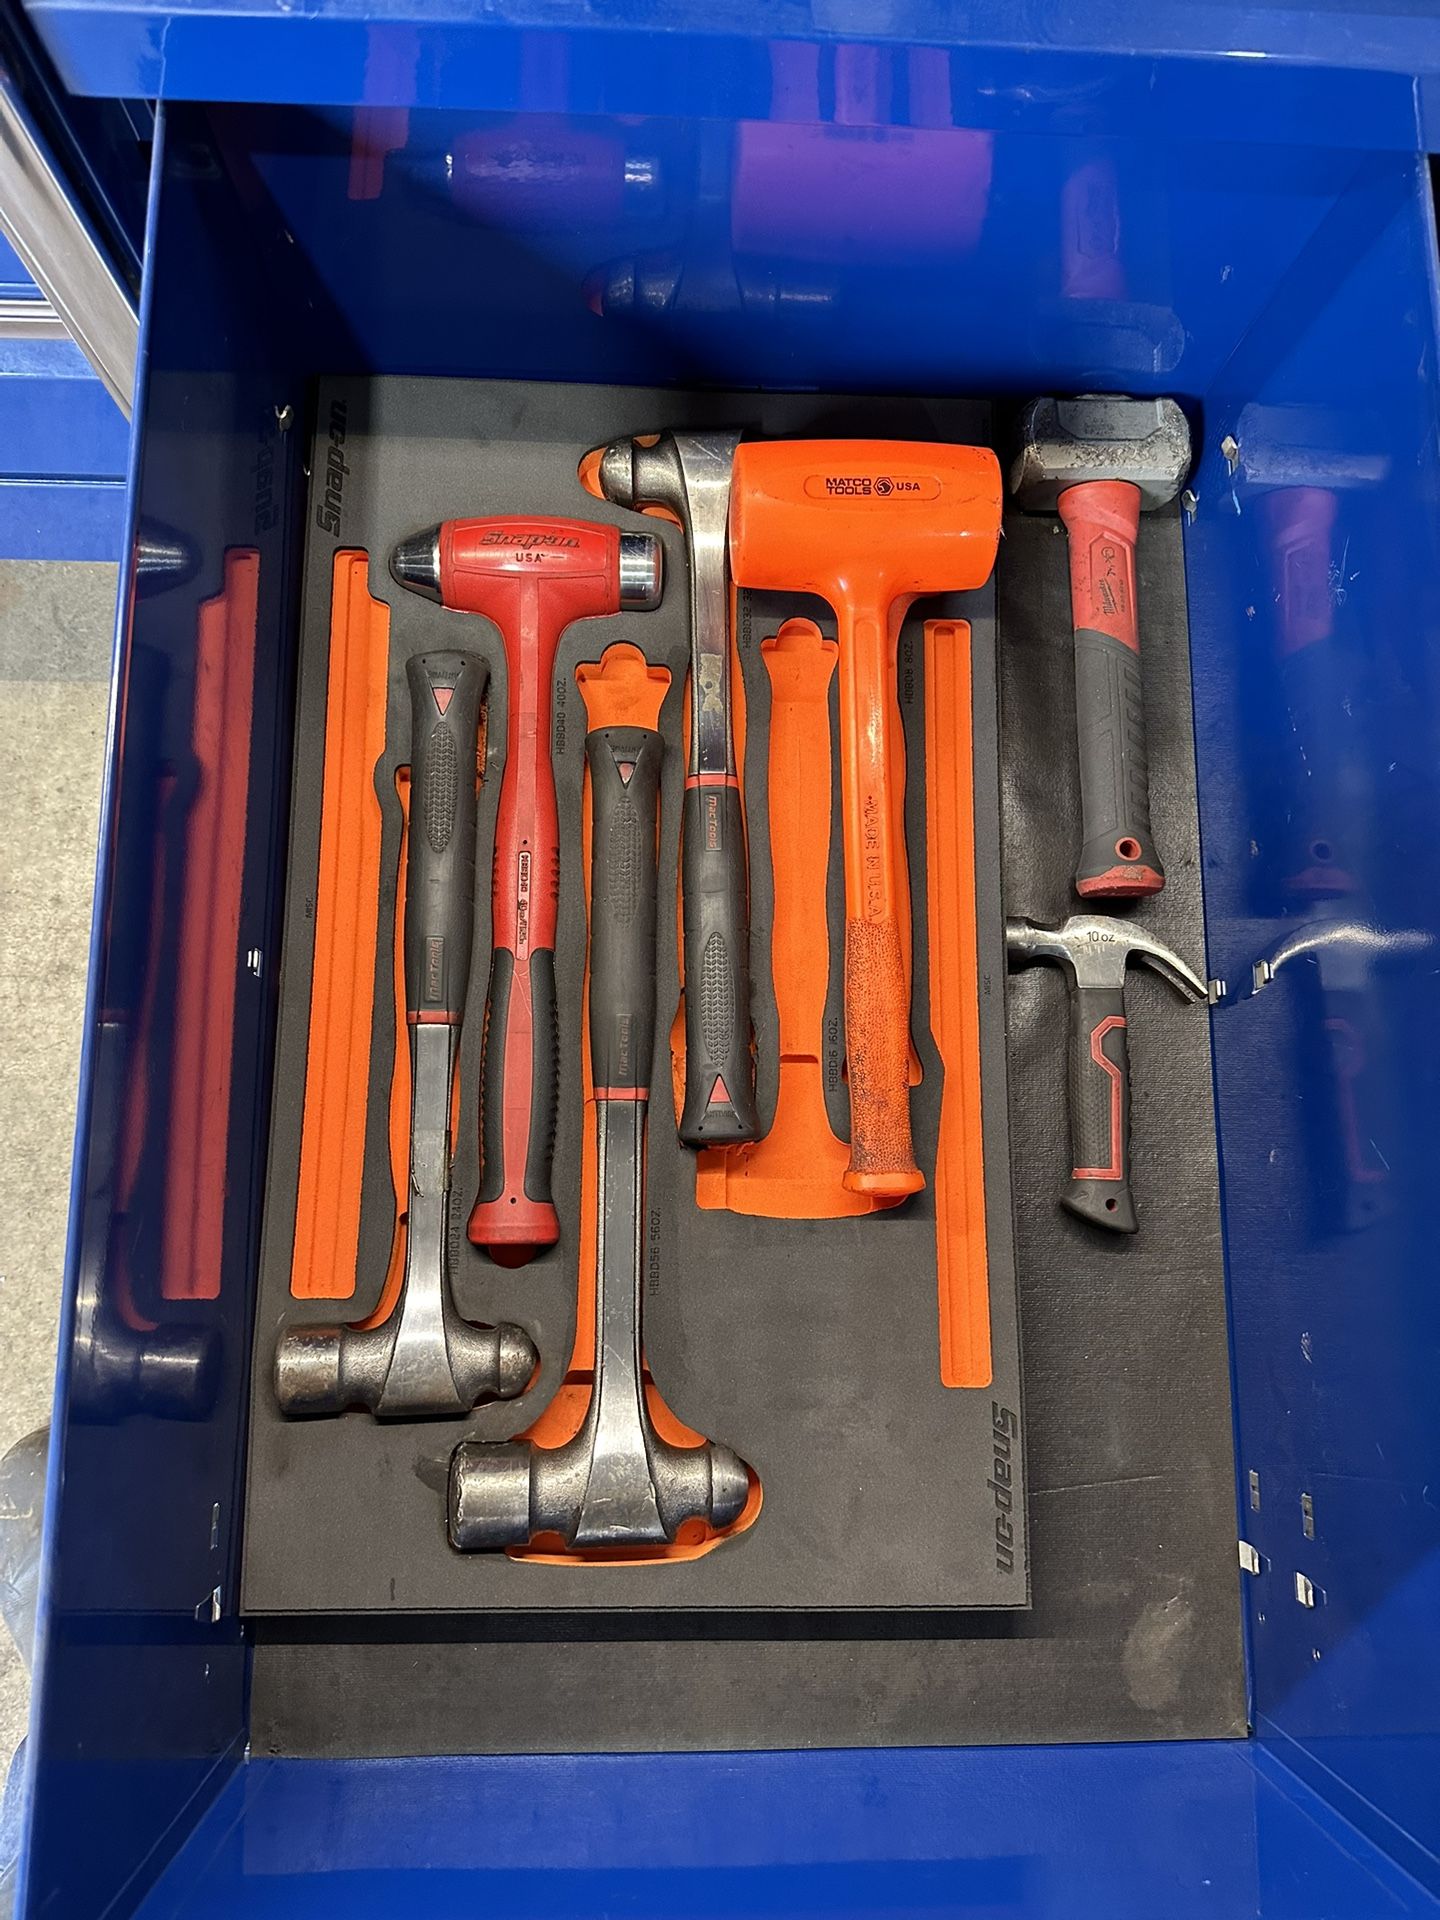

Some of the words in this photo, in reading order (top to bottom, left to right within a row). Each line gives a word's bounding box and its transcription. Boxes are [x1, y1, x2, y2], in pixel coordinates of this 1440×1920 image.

[316, 399, 350, 538] Snap-on
[826, 477, 871, 487] MATCO
[826, 486, 872, 495] TOOLS
[896, 482, 921, 491] USA
[479, 530, 580, 550] Snap-on
[515, 552, 543, 563] USA
[556, 712, 566, 755] HBBD40
[864, 799, 880, 850] MADE
[649, 1247, 660, 1296] HBBD56
[987, 1400, 1018, 1575] Snap-on
